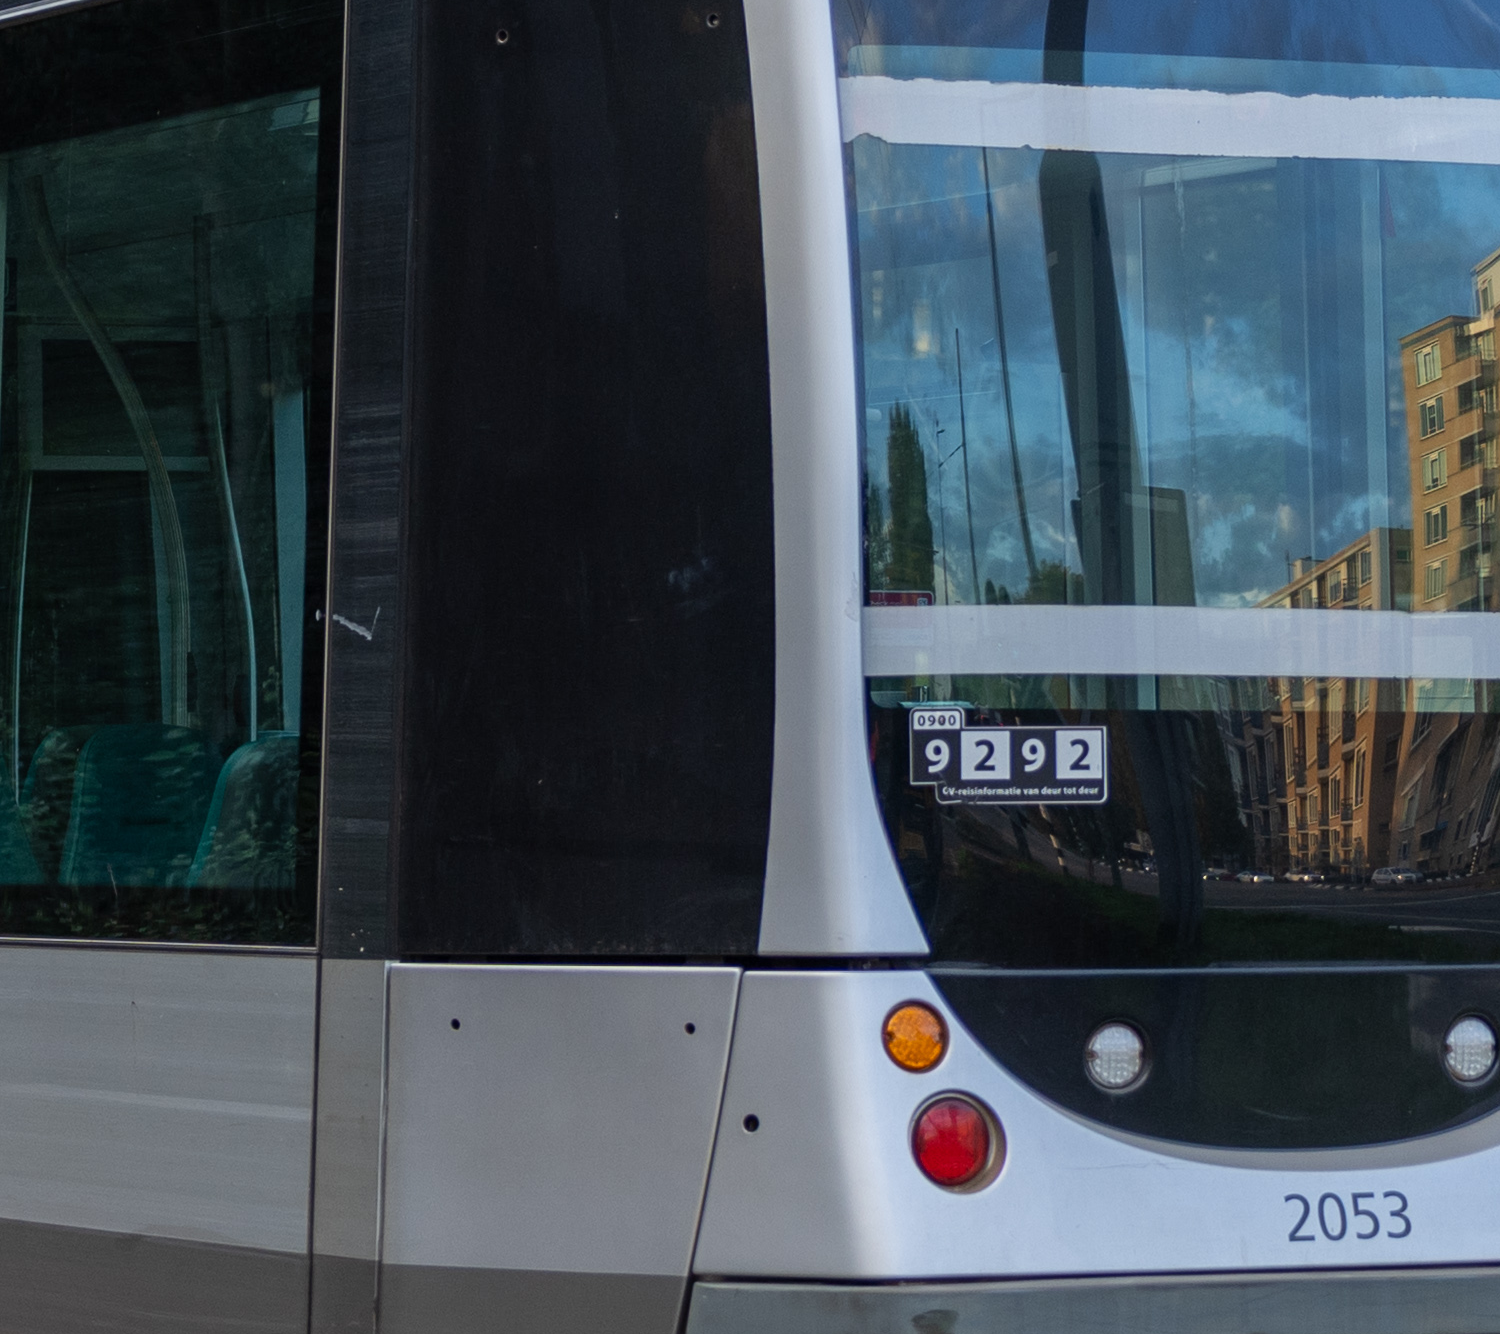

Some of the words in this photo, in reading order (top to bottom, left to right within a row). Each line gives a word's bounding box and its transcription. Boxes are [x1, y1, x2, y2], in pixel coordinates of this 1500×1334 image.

[917, 714, 957, 727] 0900
[925, 737, 1091, 773] 9292
[1023, 787, 1039, 796] van
[1040, 786, 1062, 795] deur
[1063, 786, 1077, 795] tot
[1078, 785, 1099, 795] deur
[1283, 1189, 1413, 1243] 2053
